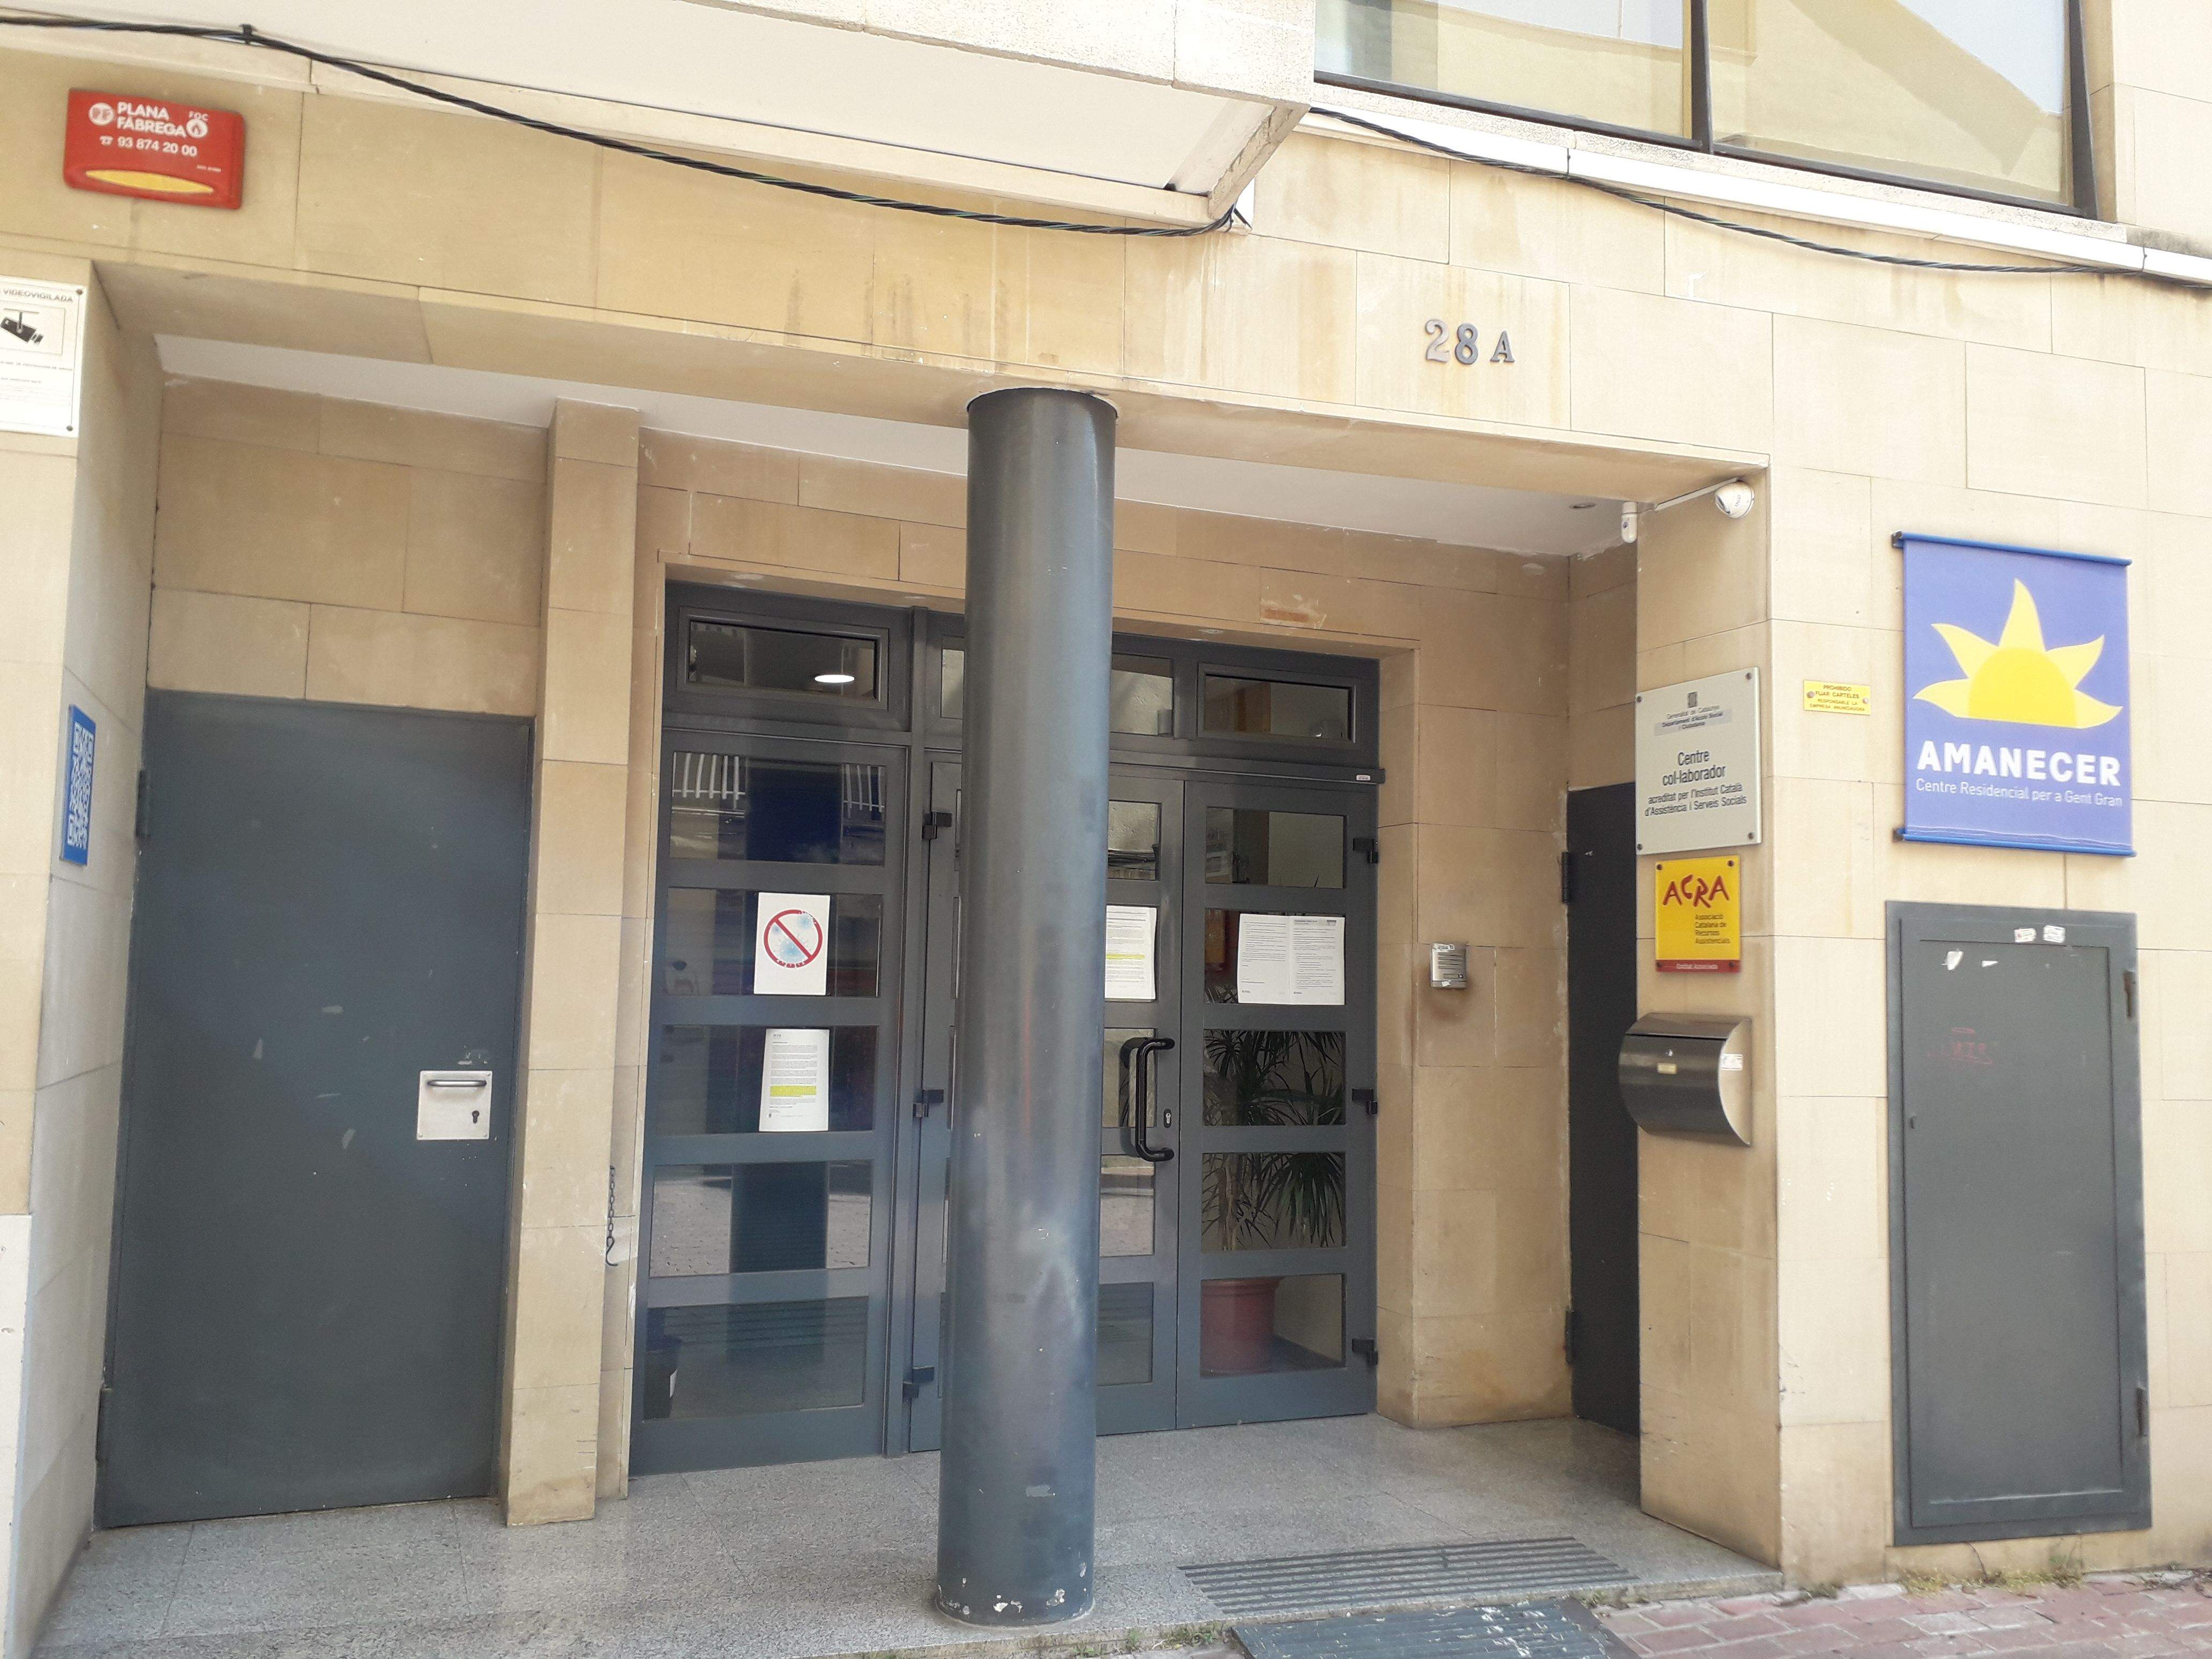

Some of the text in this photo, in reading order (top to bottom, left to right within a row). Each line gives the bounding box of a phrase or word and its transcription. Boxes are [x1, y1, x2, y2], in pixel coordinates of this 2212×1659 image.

[117, 102, 170, 120] PLANA
[189, 110, 209, 122] FOC
[117, 136, 198, 157] 93 874 20 00
[3, 288, 73, 302] VIDEOVIGILADA
[1424, 319, 1516, 365] 28 A
[1678, 750, 1710, 766] Centre
[1917, 740, 2121, 787] AMANECER
[1648, 792, 1676, 804] acreditat
[1678, 791, 1688, 802] per
[1721, 795, 1747, 806] Socials
[1916, 778, 2123, 806] Centre Residencial per a Gent Gran
[1662, 874, 1730, 908] ACRA
